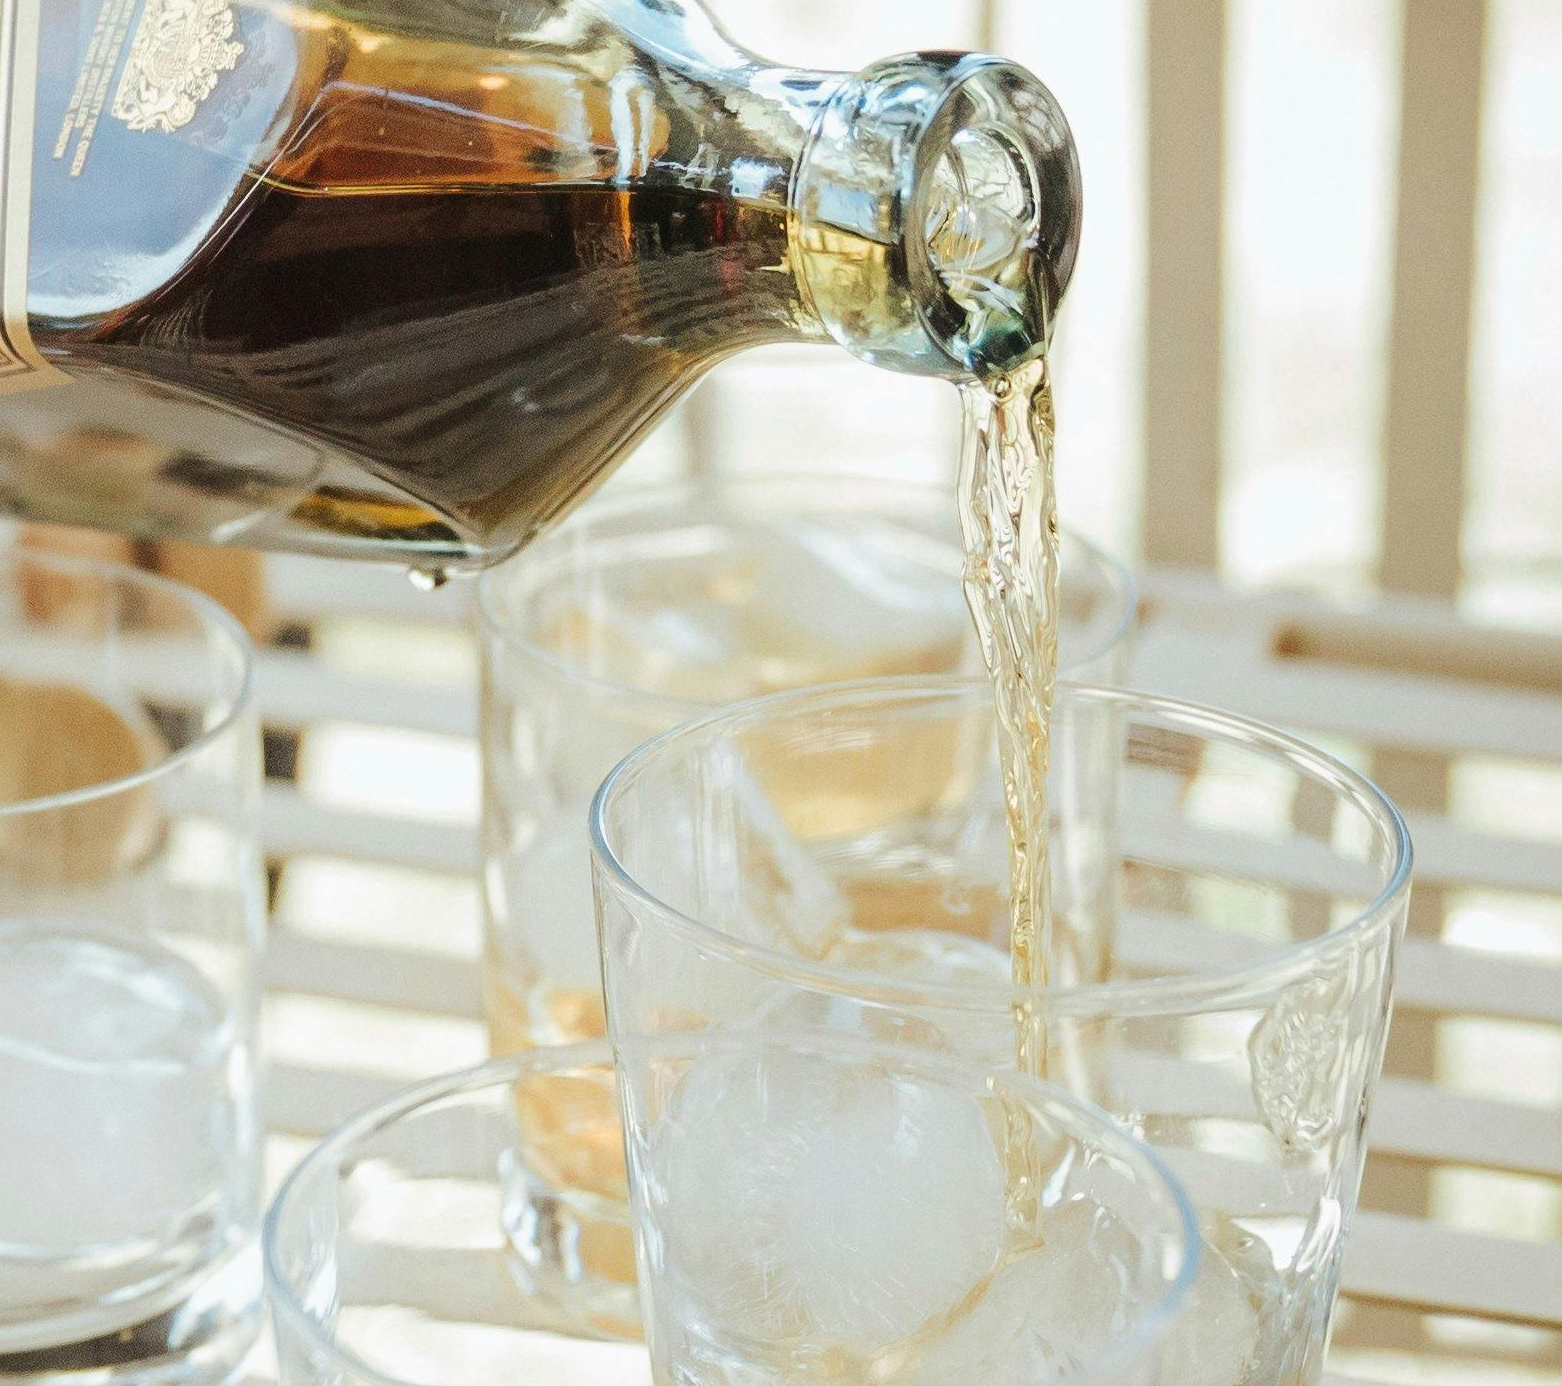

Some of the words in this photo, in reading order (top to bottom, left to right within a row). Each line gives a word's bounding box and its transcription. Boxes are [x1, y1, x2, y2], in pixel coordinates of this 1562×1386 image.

[54, 113, 75, 159] LONDON
[83, 115, 96, 138] THE
[70, 138, 89, 176] QUEEN
